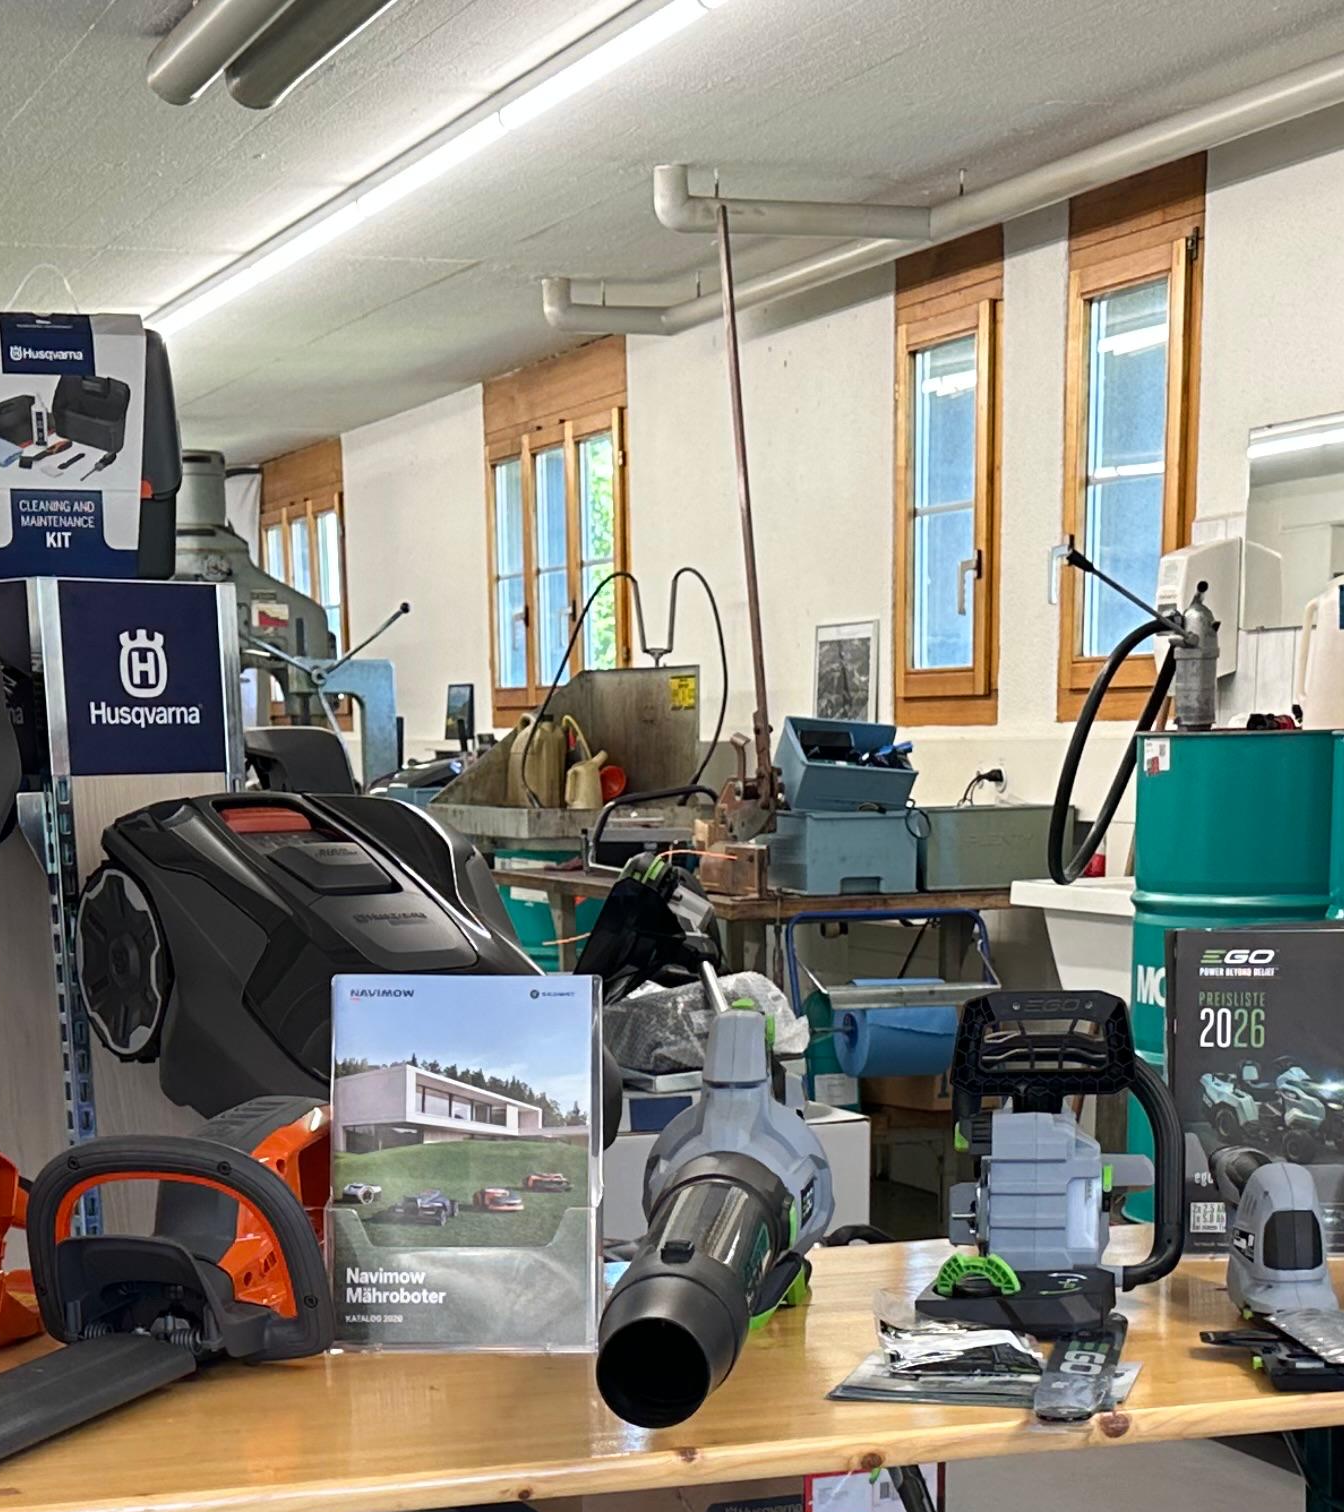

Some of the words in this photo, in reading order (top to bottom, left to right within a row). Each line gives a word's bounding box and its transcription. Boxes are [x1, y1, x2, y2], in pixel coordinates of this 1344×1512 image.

[23, 348, 84, 361] Husqvarna
[19, 499, 71, 512] CLEANING
[72, 500, 96, 513] AND
[20, 514, 96, 528] MAINTENANCE
[45, 531, 72, 548] KIT
[90, 701, 201, 728] Husqvarna
[1200, 949, 1276, 964] EGO
[1199, 967, 1225, 977] POWER
[1225, 967, 1252, 977] BEYOND
[1253, 967, 1275, 977] BELIEF
[350, 988, 415, 999] NAVIMOW
[1198, 991, 1266, 1008] PREISLISTE
[1199, 1008, 1266, 1048] 2026
[345, 1267, 426, 1285] Navimow
[345, 1286, 447, 1305] Mähroboter
